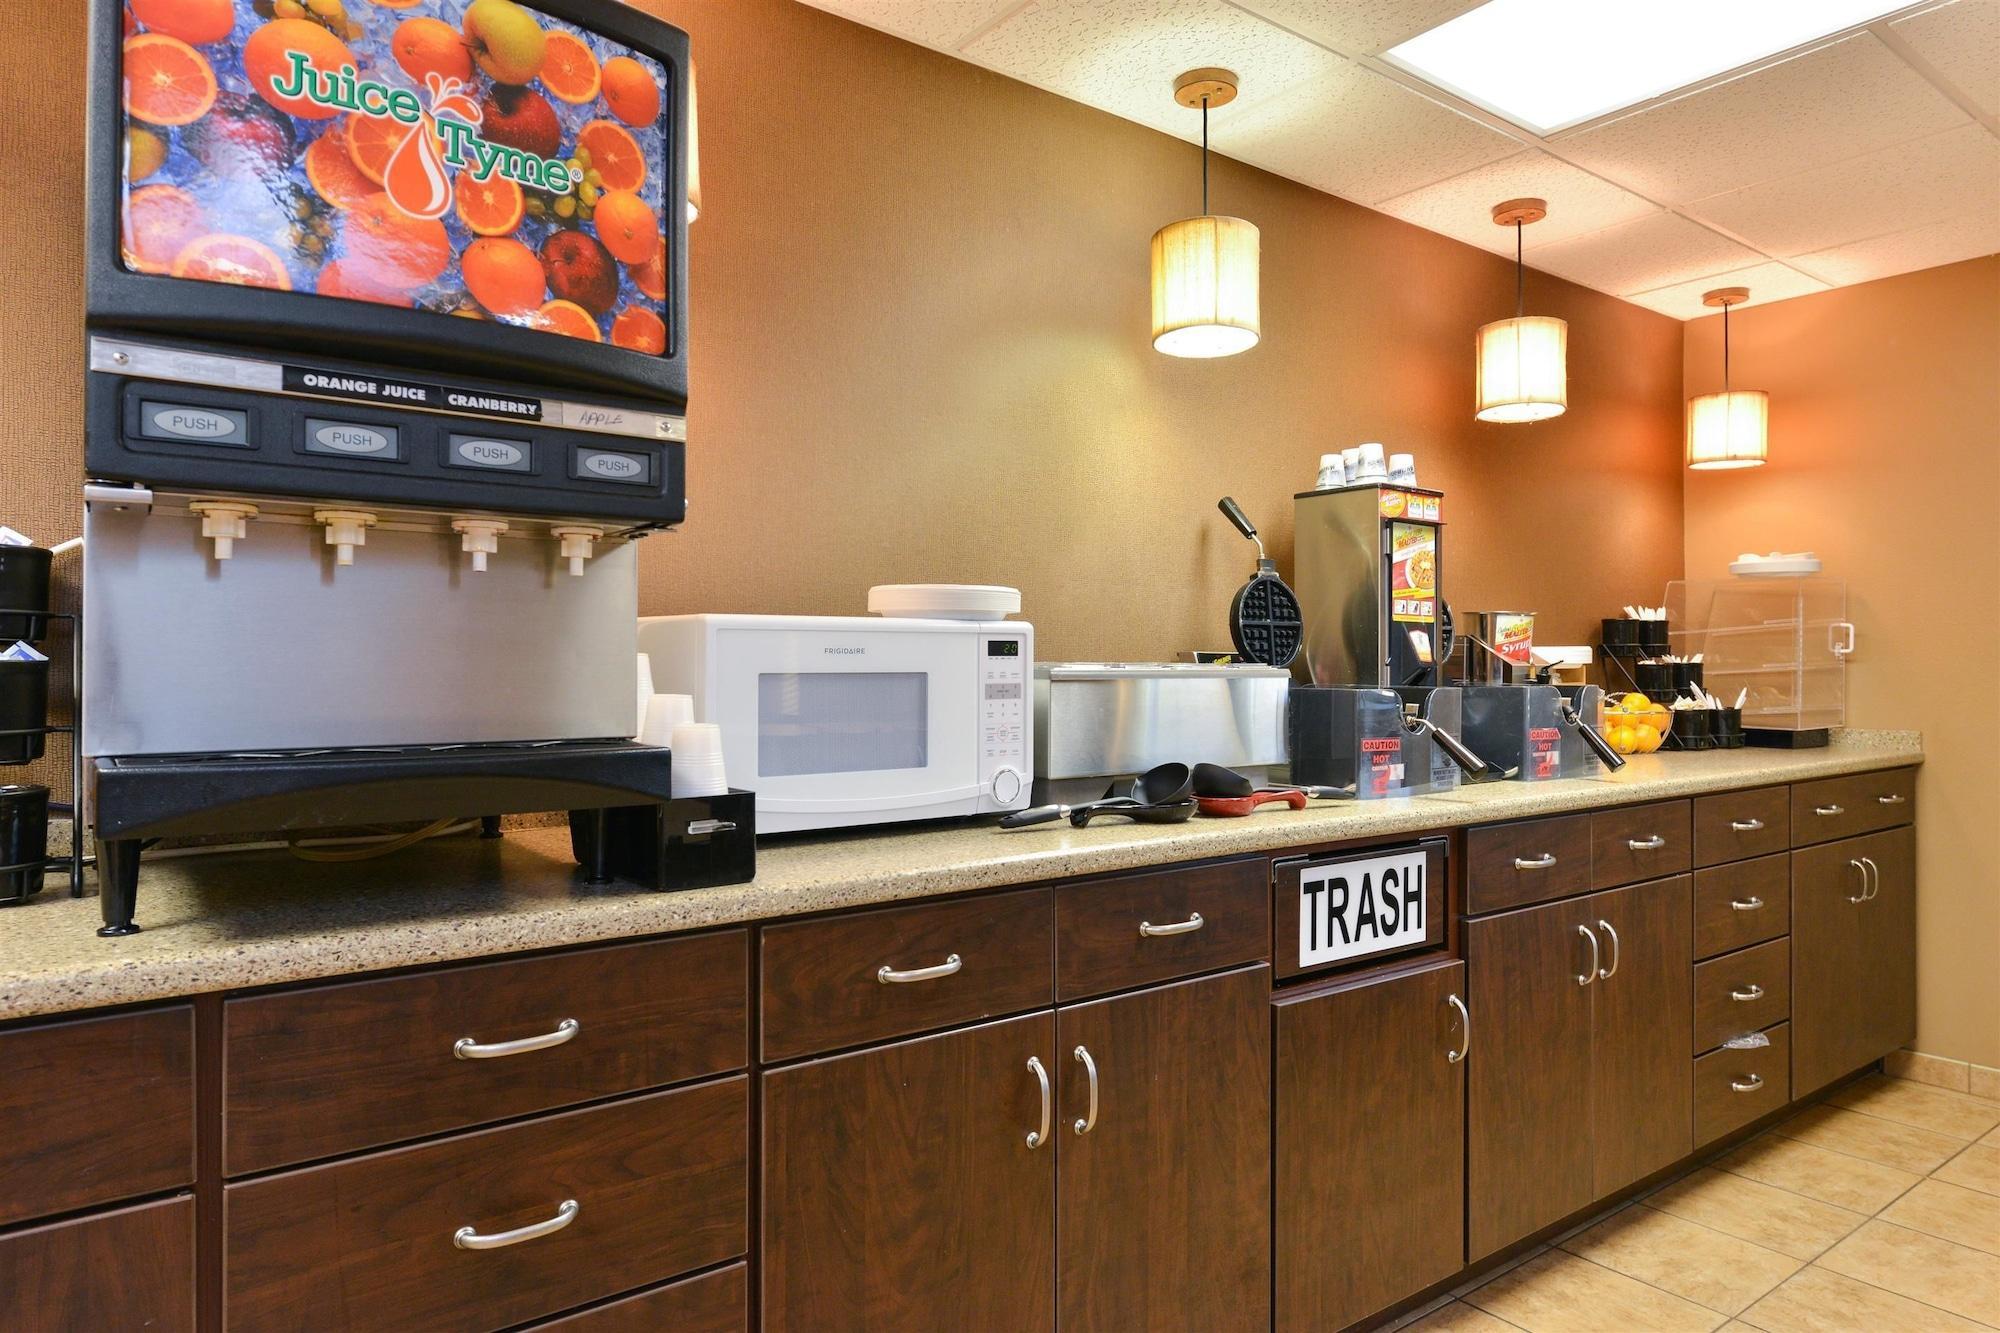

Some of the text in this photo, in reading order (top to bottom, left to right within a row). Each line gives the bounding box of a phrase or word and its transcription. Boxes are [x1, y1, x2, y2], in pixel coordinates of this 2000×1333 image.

[272, 51, 422, 123] Juice
[302, 373, 426, 402] ORANGE JUICE
[447, 393, 538, 416] CRANBERRY
[172, 415, 218, 432] PUSH
[578, 410, 624, 426] APPLE
[332, 431, 373, 447] PUSH
[472, 446, 509, 460] PUSH
[597, 458, 630, 472] PUSH
[824, 647, 865, 655] FRIGIDAIRE
[1362, 740, 1400, 751] CAUTION
[1538, 742, 1553, 752] HOT
[1372, 754, 1391, 765] HOT
[1303, 864, 1423, 951] TRASH
